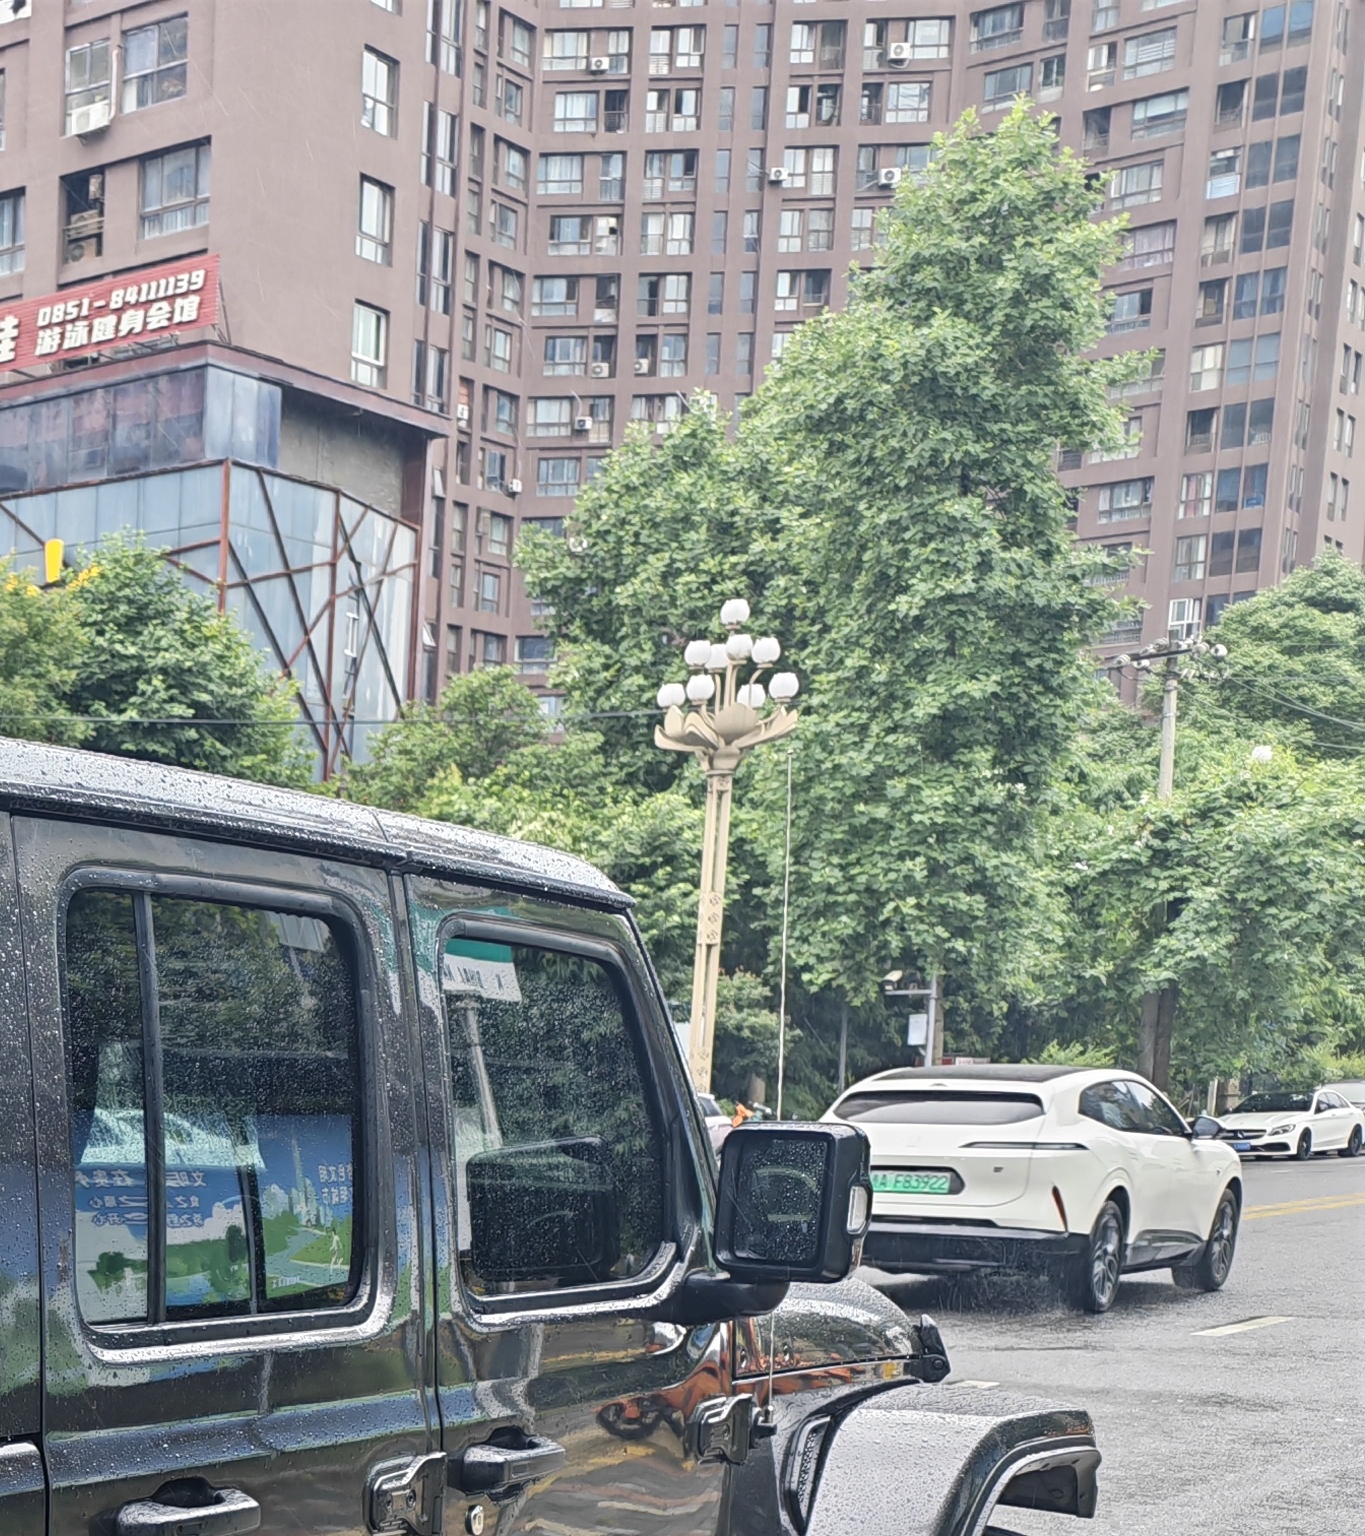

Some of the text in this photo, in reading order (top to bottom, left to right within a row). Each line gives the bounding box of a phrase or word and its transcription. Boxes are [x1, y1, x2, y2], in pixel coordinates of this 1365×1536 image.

[35, 295, 201, 357] 游泳健身会馆
